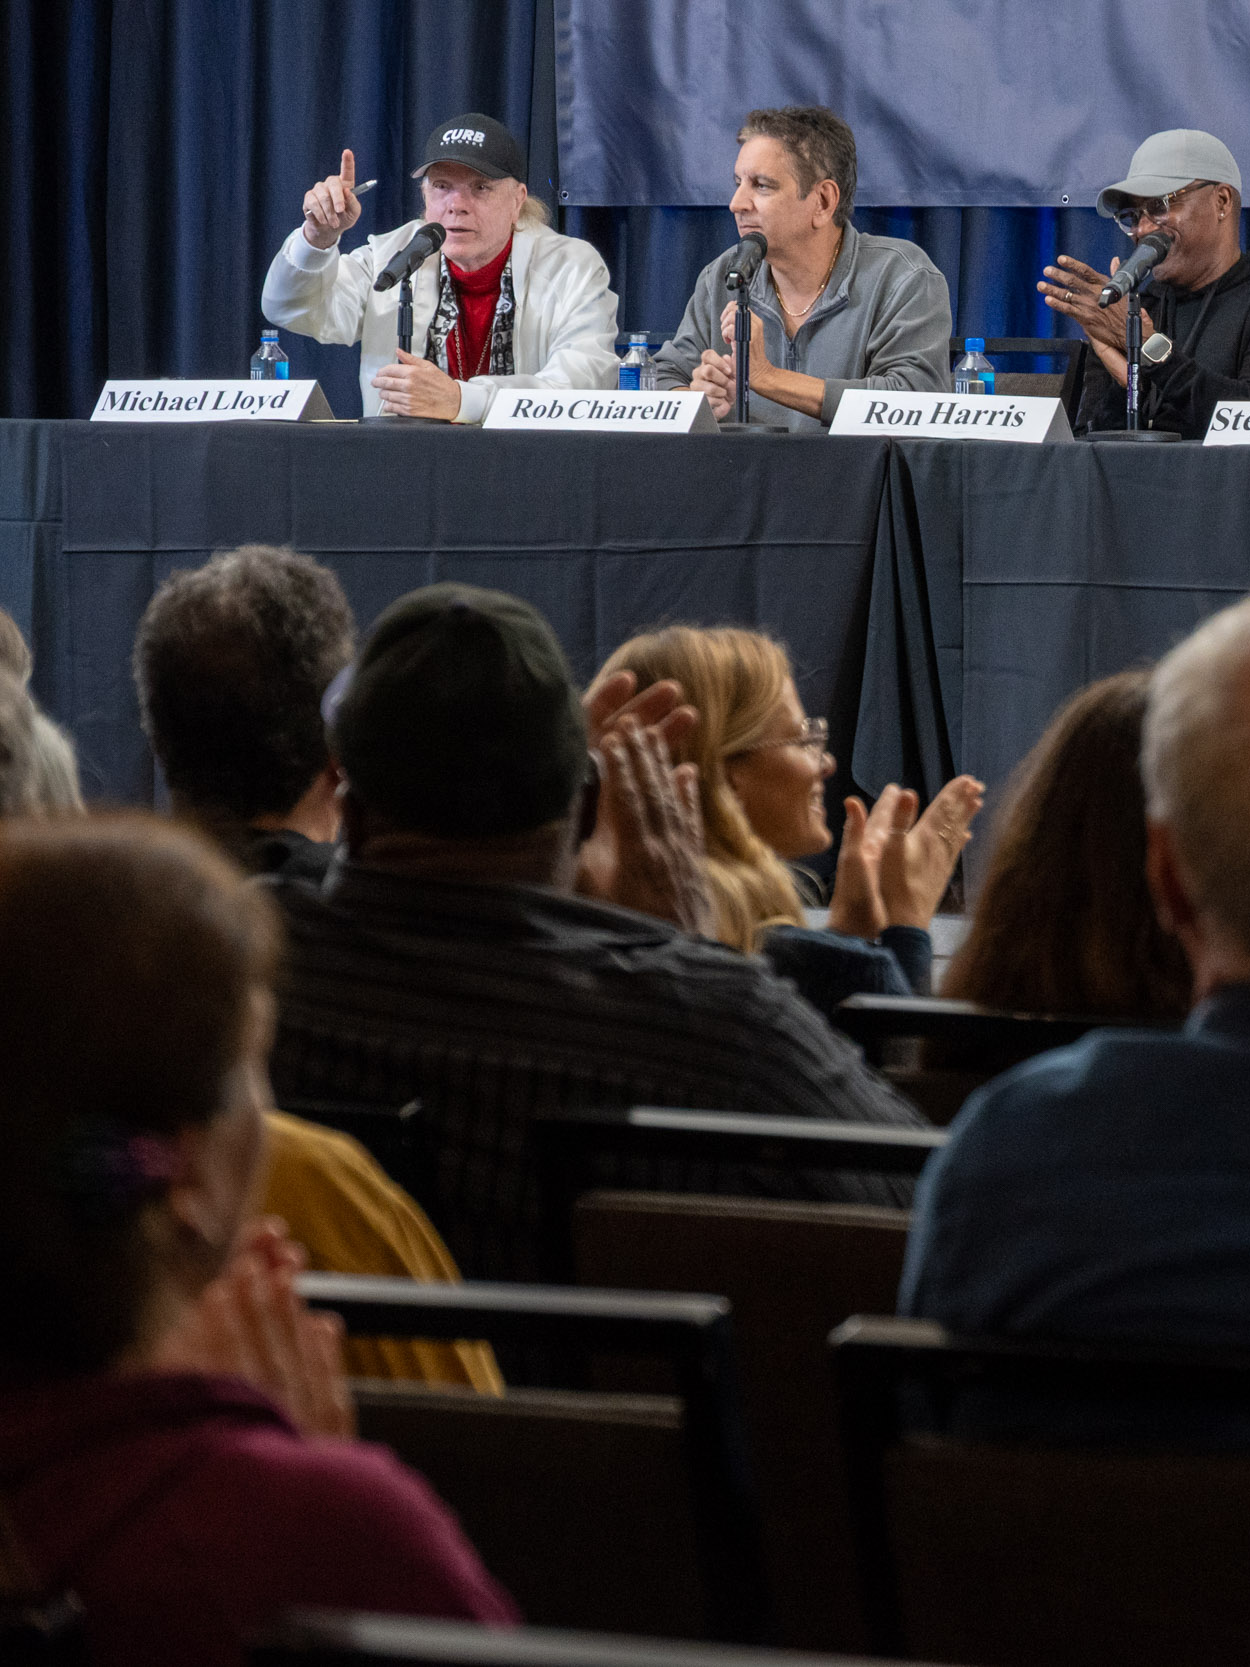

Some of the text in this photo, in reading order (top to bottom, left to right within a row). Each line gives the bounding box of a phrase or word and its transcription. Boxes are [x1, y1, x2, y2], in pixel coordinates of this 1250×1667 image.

[442, 129, 485, 143] CURB
[100, 390, 290, 414] Michael Lloyd
[511, 398, 682, 420] Rob Chiarelli
[861, 401, 1026, 427] Ron Harris
